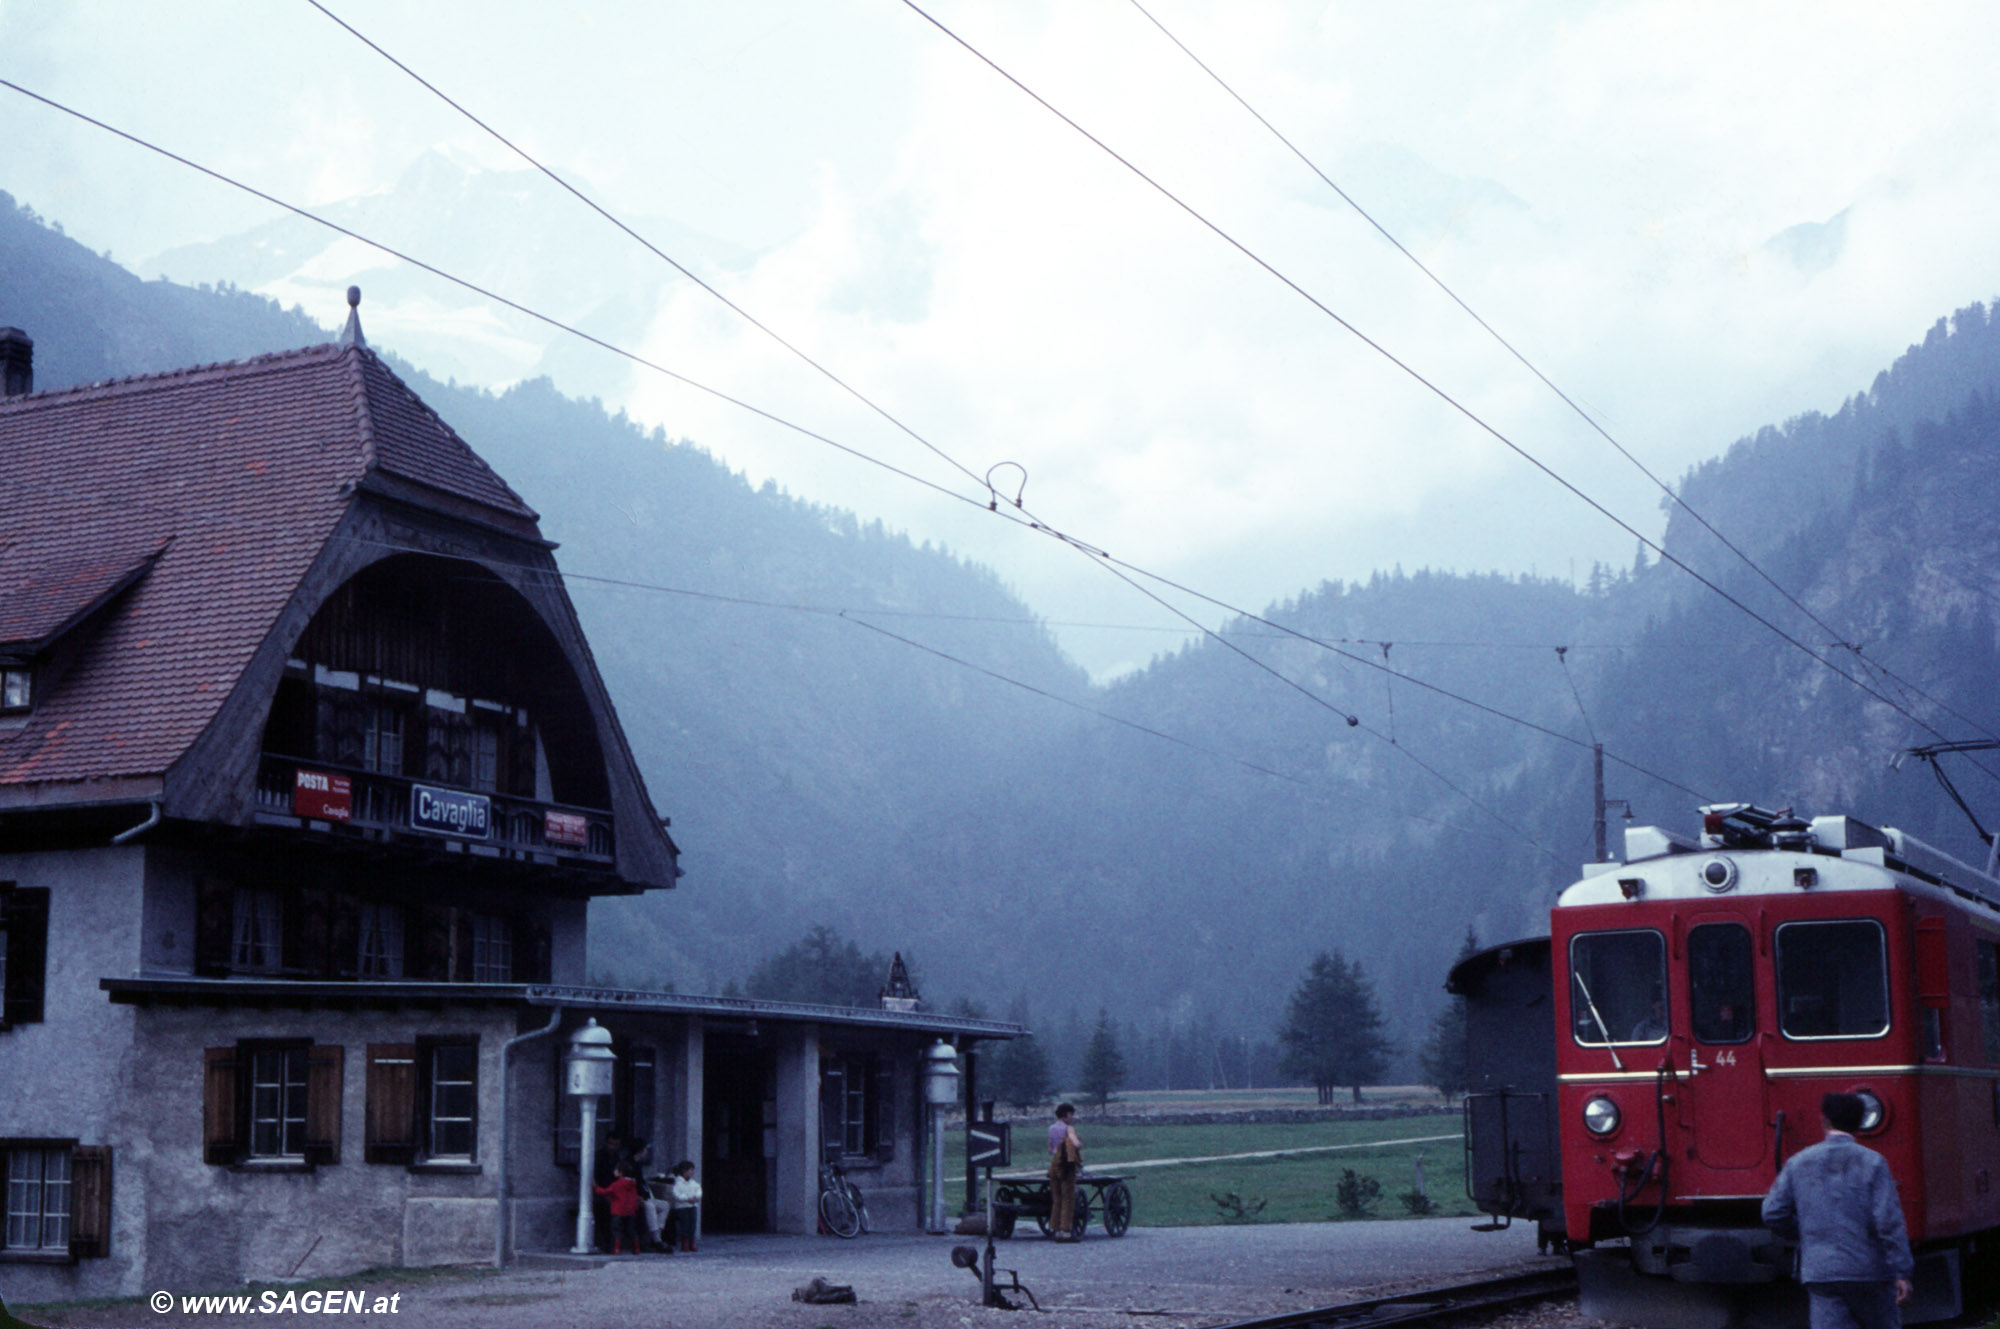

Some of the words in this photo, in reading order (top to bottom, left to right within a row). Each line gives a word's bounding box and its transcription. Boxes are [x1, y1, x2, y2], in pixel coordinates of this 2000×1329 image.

[297, 771, 329, 792] POSTA
[420, 791, 485, 832] Cavaglia
[1715, 1050, 1736, 1067] 44
